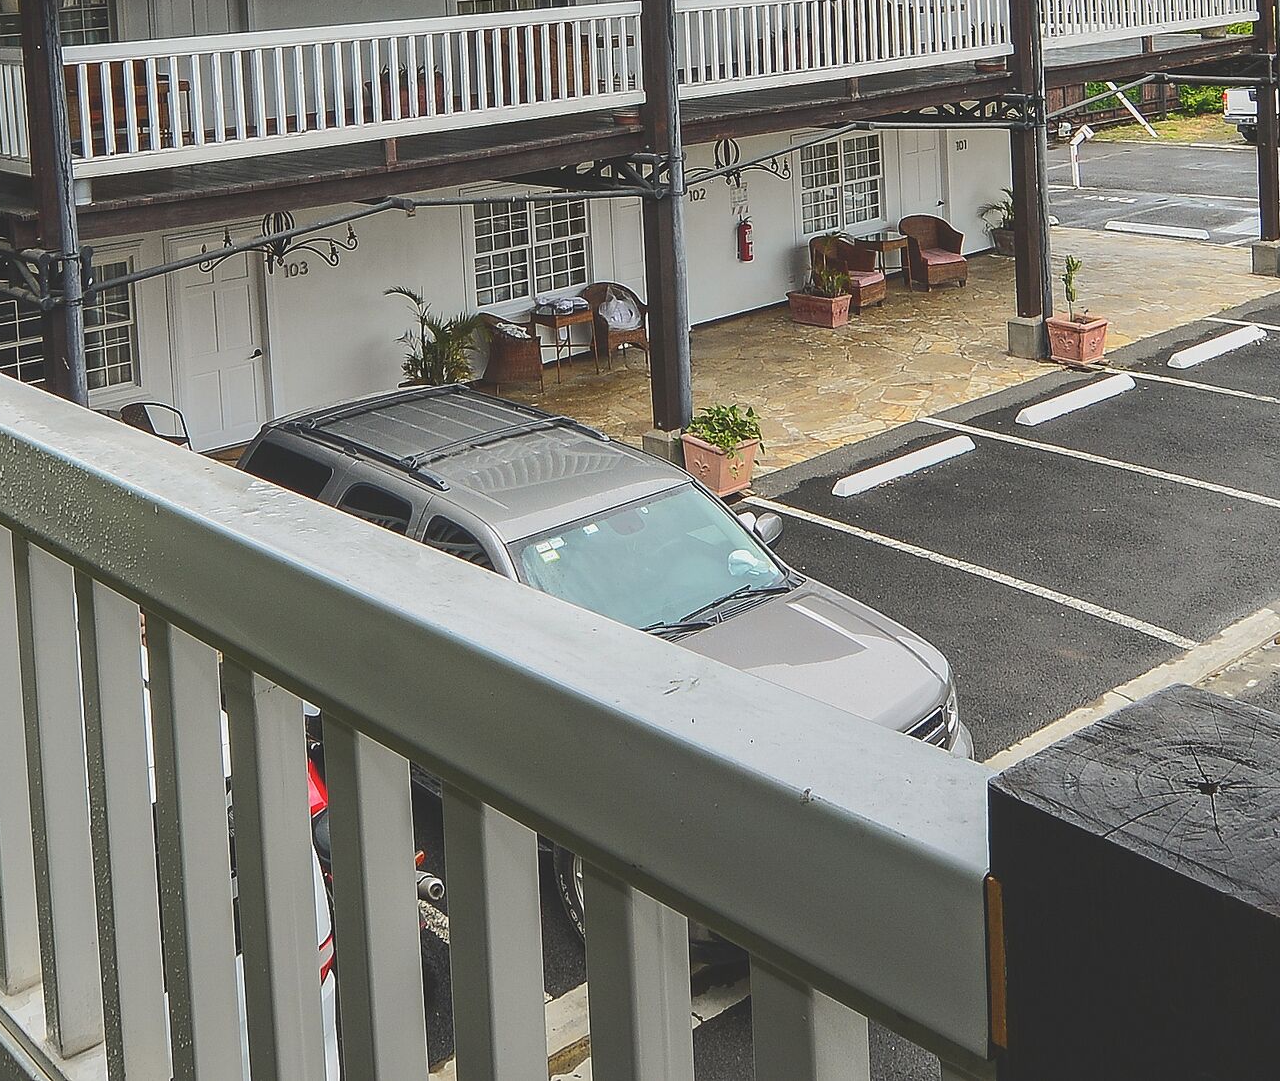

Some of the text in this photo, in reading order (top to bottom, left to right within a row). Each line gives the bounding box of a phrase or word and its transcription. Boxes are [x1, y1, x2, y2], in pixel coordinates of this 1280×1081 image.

[955, 139, 968, 151] 101
[688, 187, 707, 203] 102
[283, 260, 309, 278] 103
